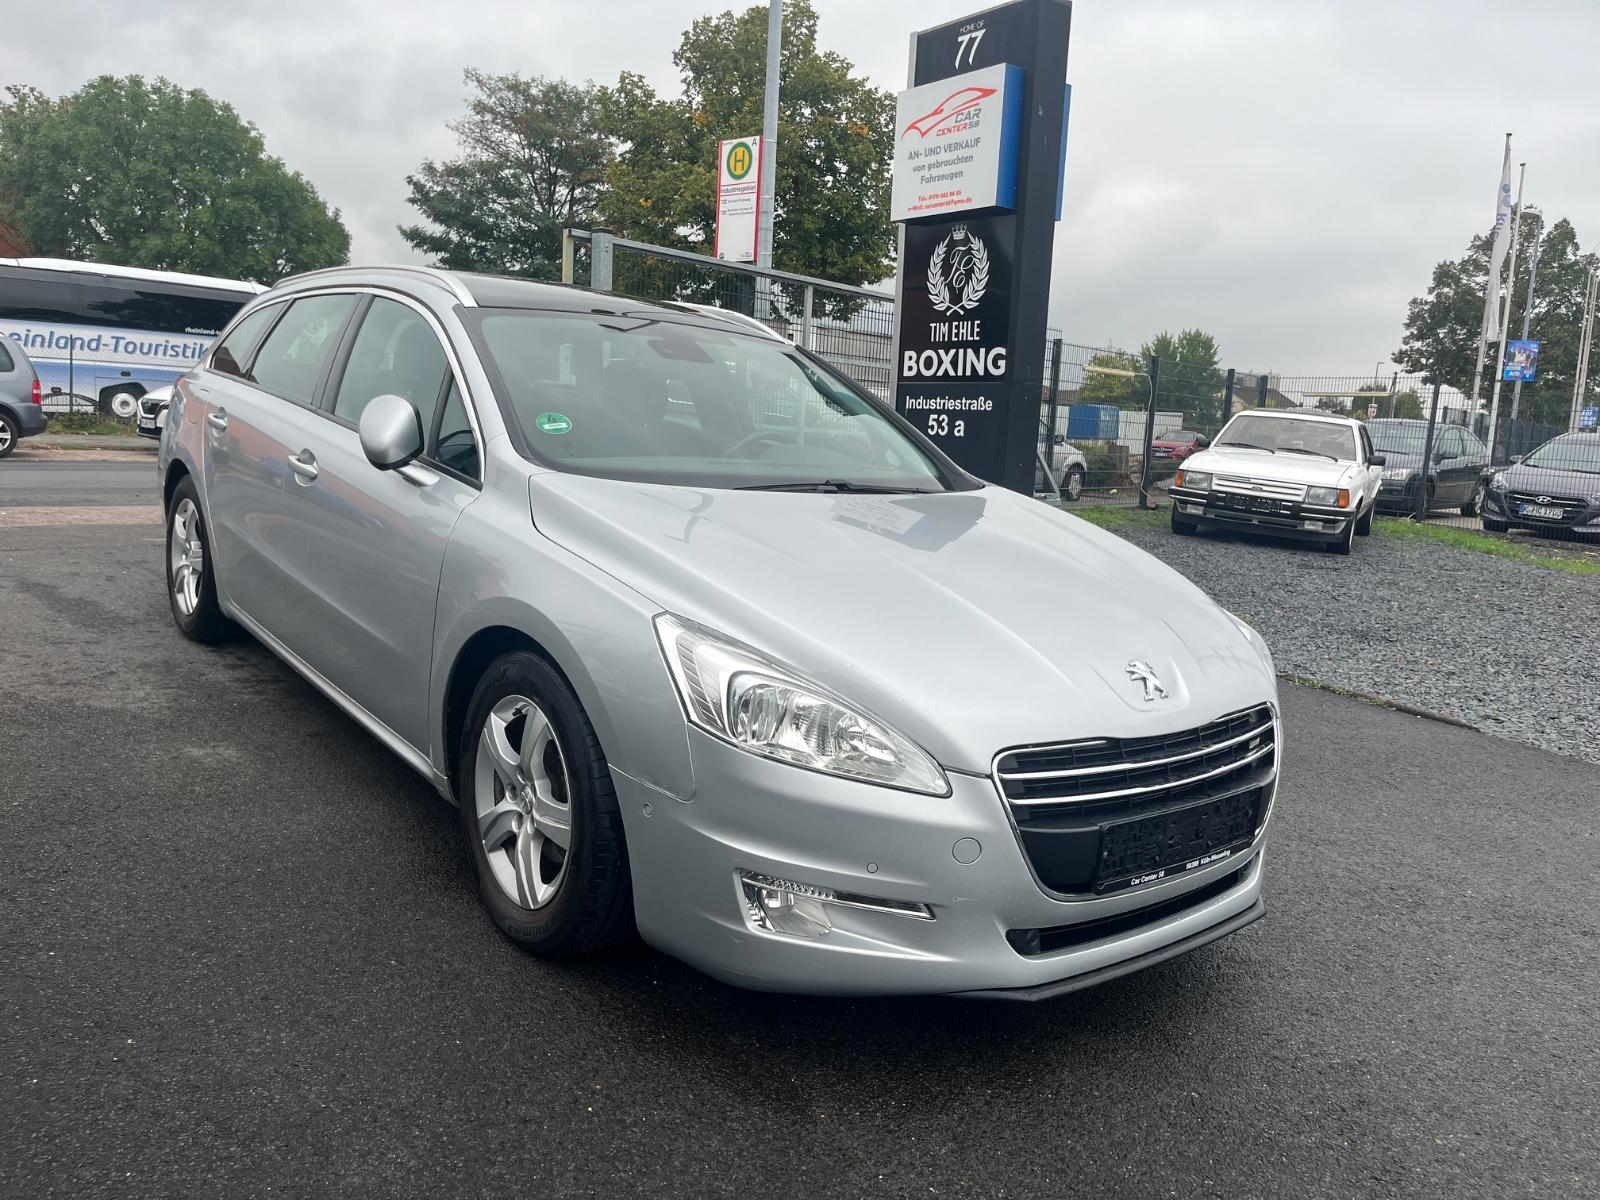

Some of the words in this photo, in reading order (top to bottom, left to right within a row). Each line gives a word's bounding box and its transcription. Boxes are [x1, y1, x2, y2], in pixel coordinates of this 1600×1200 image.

[960, 24, 975, 34] HOME
[975, 20, 985, 30] OF
[954, 28, 986, 70] 77
[954, 107, 982, 124] CAR
[751, 137, 757, 146] A
[907, 146, 923, 161] AN-
[924, 143, 942, 158] UND
[943, 137, 981, 154] VERKAUF
[733, 150, 746, 172] H
[912, 163, 926, 173] von
[926, 154, 974, 172] gebrauchten
[920, 170, 963, 185] Fahrzeugen
[929, 322, 949, 342] TIM
[951, 320, 981, 341] EHLE
[902, 346, 1007, 377] BOXING
[905, 395, 993, 411] Industriestraße
[927, 413, 949, 436] 53
[954, 420, 965, 437] a
[1140, 873, 1158, 883] Center
